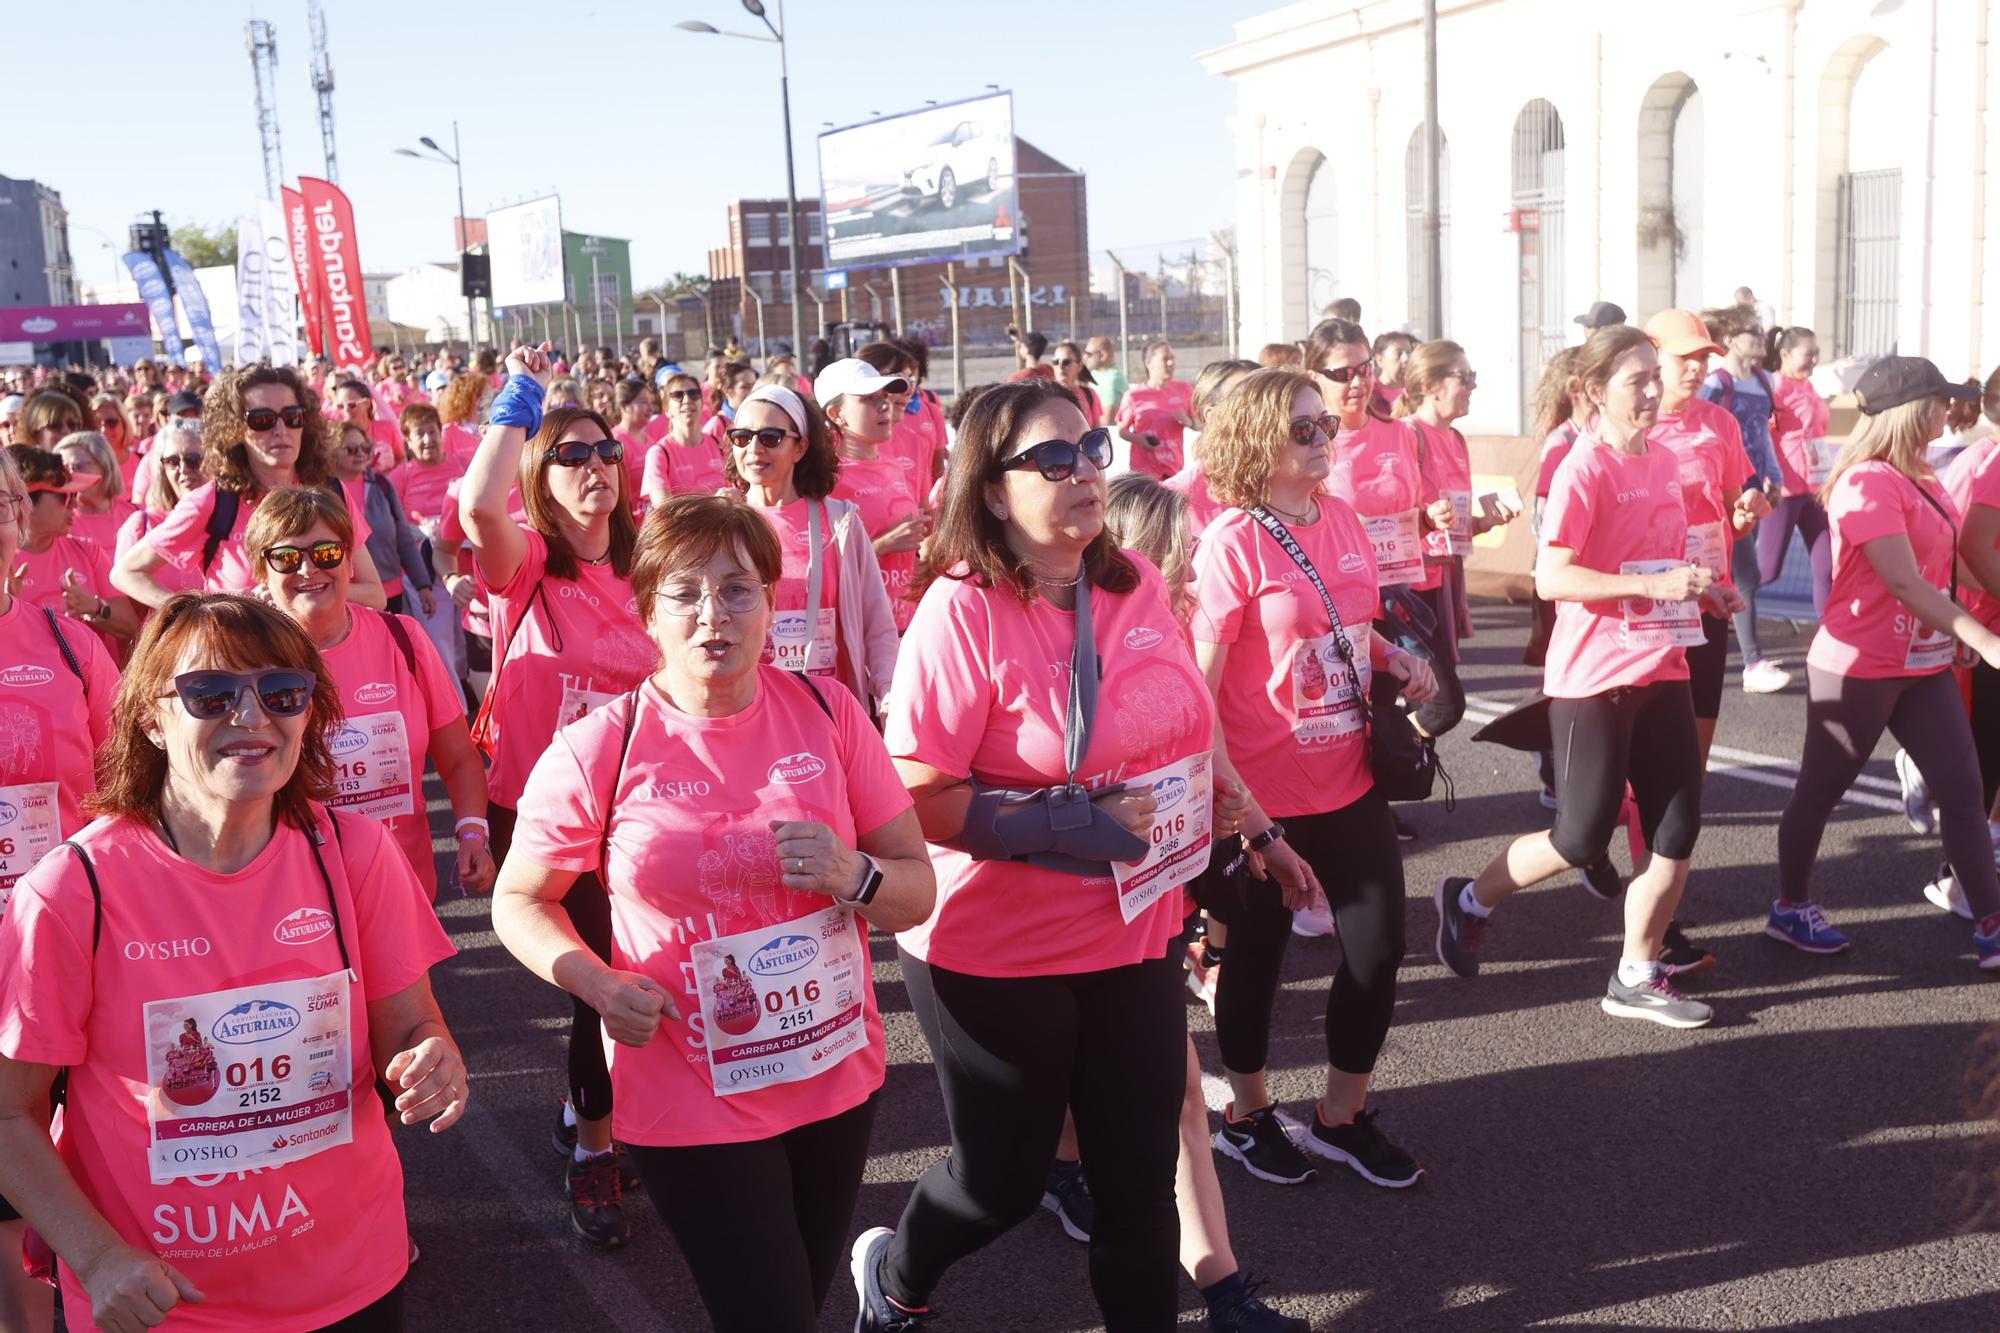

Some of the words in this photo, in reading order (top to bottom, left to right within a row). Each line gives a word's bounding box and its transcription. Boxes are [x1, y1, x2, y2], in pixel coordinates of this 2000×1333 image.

[372, 726, 397, 736] SUMA
[1306, 720, 1339, 731] OYSHO
[340, 761, 367, 778] 16
[635, 780, 710, 802] OYSHO
[22, 799, 48, 809] SUMA
[365, 801, 403, 815] Santander
[1152, 814, 1185, 845] 016
[1159, 838, 1179, 858] 2086
[1130, 868, 1158, 887] CARRERA
[1128, 885, 1157, 908] OYSHO
[280, 919, 331, 941] ASTURIANA
[822, 923, 847, 940] SUMA
[124, 937, 211, 961] OYSHO
[755, 944, 815, 972] ASTURIANA
[307, 995, 316, 1003] TU
[307, 997, 339, 1012] SUMA
[765, 979, 820, 1013] 016
[219, 1016, 294, 1039] ASTURIANA
[779, 1009, 814, 1031] 2151
[731, 1043, 780, 1058] CARRERA
[782, 1038, 796, 1047] DE
[798, 1033, 810, 1044] LA
[812, 1021, 837, 1039] MUJER
[823, 1030, 857, 1057] Santander
[226, 1054, 291, 1087] 016
[730, 1061, 784, 1082] OYSHO
[239, 1087, 281, 1107] 2152
[179, 1120, 235, 1133] CARRERA
[238, 1117, 255, 1128] DE
[257, 1115, 272, 1125] LA
[275, 1106, 311, 1123] MUJER
[314, 1099, 336, 1112] 2023
[289, 1122, 339, 1146] Santander
[174, 1145, 238, 1163] OYSHO
[152, 1184, 310, 1244] SUMA
[207, 1248, 223, 1258] DE
[225, 1246, 239, 1256] LA
[241, 1235, 278, 1252] MUJER
[290, 1219, 316, 1237] 2023
